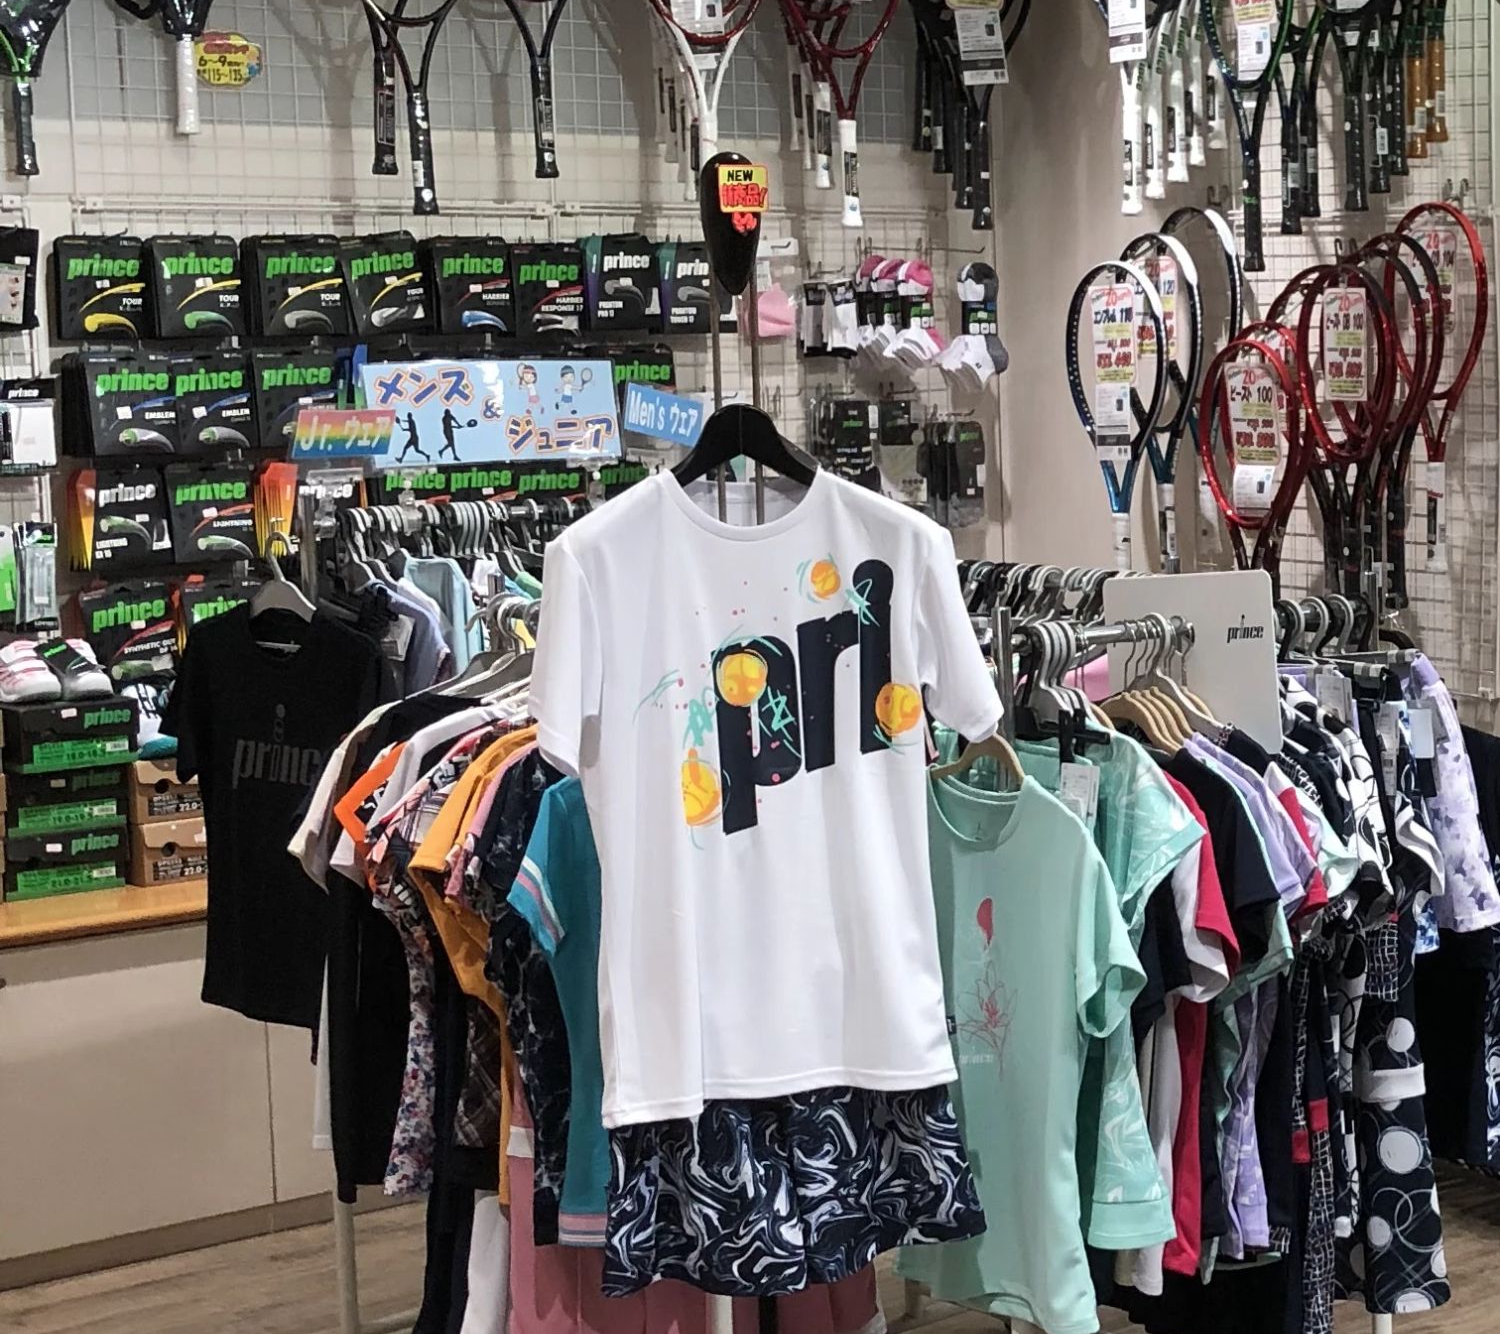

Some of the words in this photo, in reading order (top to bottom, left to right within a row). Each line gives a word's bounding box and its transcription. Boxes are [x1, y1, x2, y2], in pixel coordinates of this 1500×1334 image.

[728, 169, 753, 182] NEW
[67, 253, 140, 280] prince
[164, 252, 234, 278] prince
[266, 251, 337, 279] prince
[351, 251, 415, 279] prince
[442, 253, 505, 278] prince
[519, 260, 579, 285] prince
[603, 250, 650, 270] prince
[122, 296, 143, 306] TOUR
[218, 294, 239, 303] TOUR
[320, 293, 341, 301] TOUR
[97, 369, 169, 397] prince
[175, 368, 244, 397] prince
[262, 363, 332, 391] prince
[615, 359, 671, 385] prince
[373, 367, 473, 408] メンズ
[1257, 386, 1273, 403] 100
[144, 410, 176, 420] EMBLEM
[221, 408, 250, 419] EMBLEM
[481, 396, 502, 421] &
[627, 392, 666, 432] Men's
[667, 403, 699, 438] ウェア
[505, 414, 616, 455] ジュニア
[175, 479, 247, 506] prince
[450, 468, 512, 494] prince
[518, 470, 580, 495] prince
[99, 483, 157, 507] prince
[93, 597, 167, 633] prince
[1226, 614, 1265, 644] prince
[84, 707, 131, 729] prince
[71, 833, 120, 856] prince
